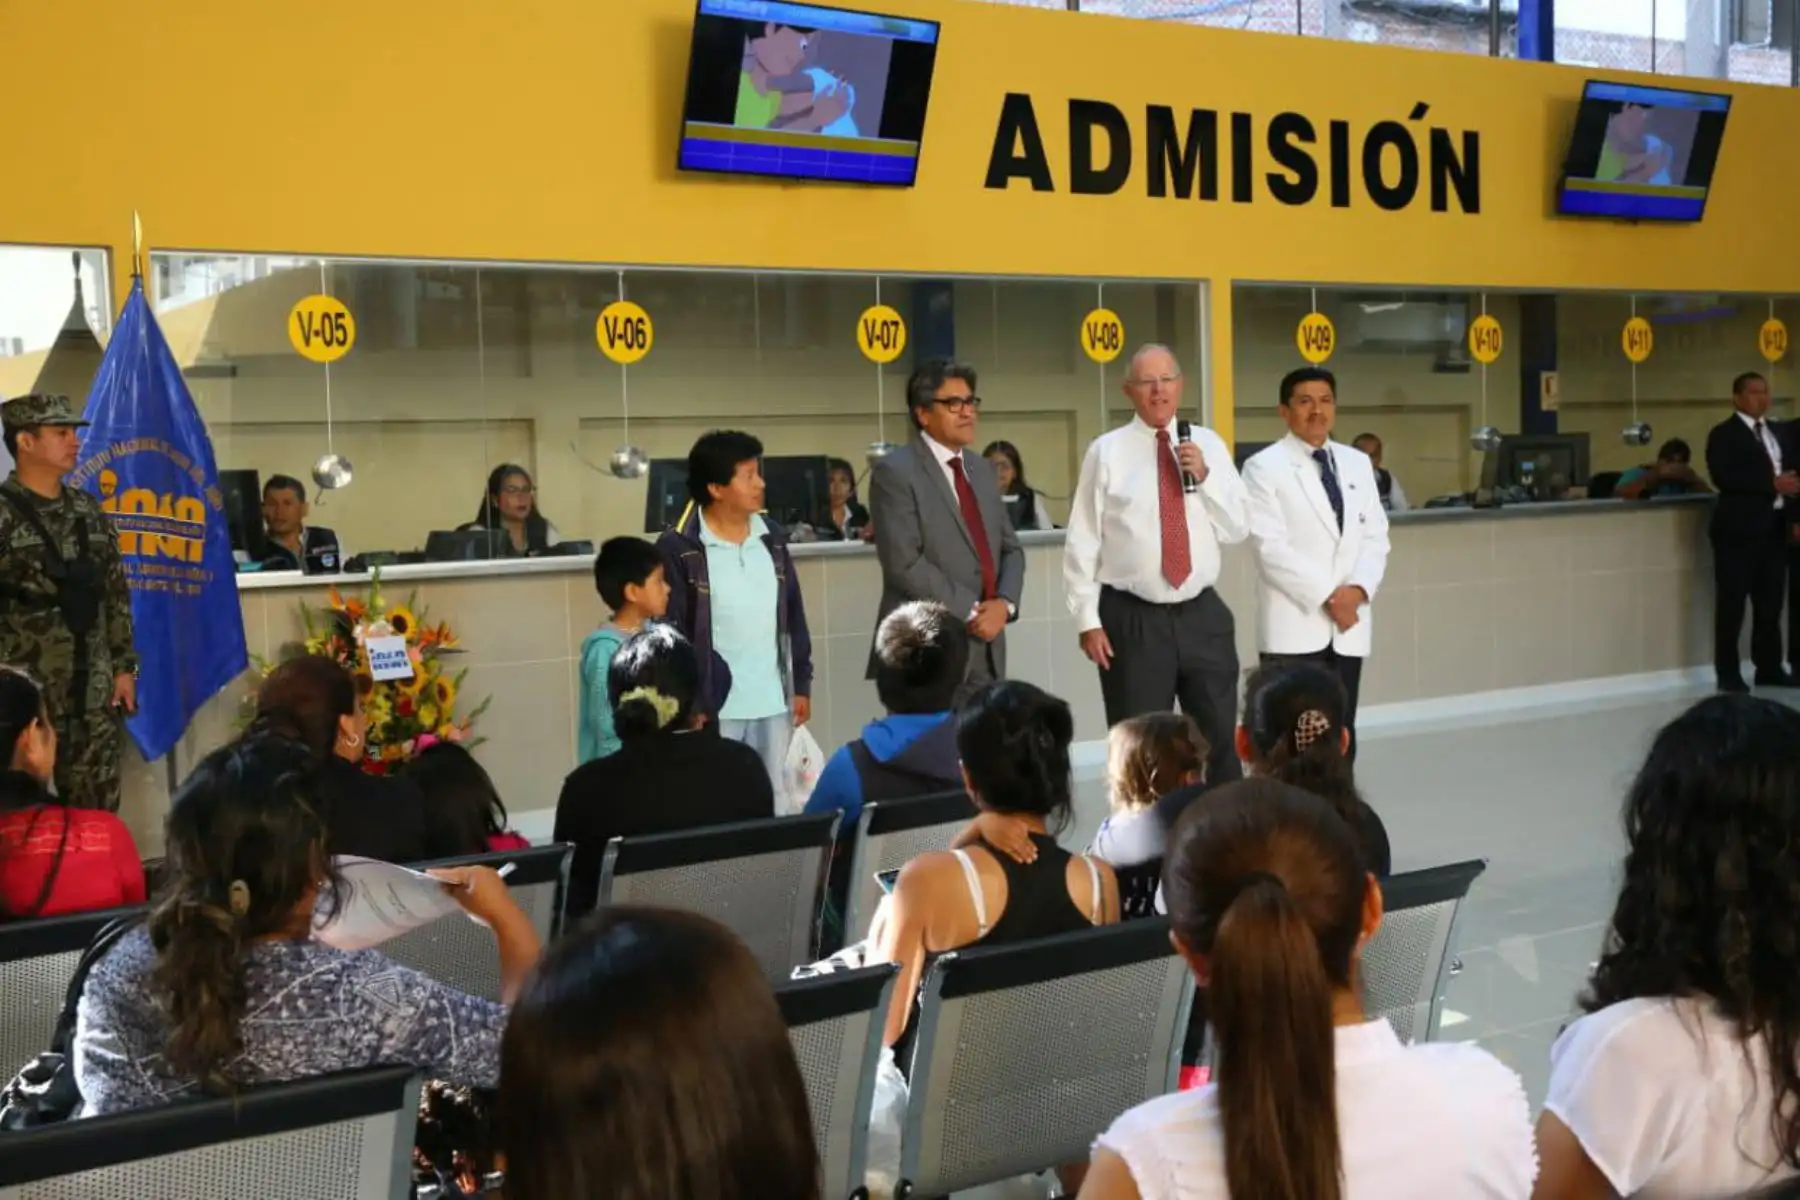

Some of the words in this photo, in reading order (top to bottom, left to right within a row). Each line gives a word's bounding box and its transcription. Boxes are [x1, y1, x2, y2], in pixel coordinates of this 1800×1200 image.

[985, 93, 1480, 214] ADMISIÓN
[296, 310, 348, 347] V-05
[603, 315, 647, 349] V-06
[863, 318, 900, 349] V-07
[1087, 321, 1119, 351] V-08
[1301, 324, 1331, 352] V-09
[1474, 326, 1500, 353] V-10
[1627, 327, 1648, 353] V-11
